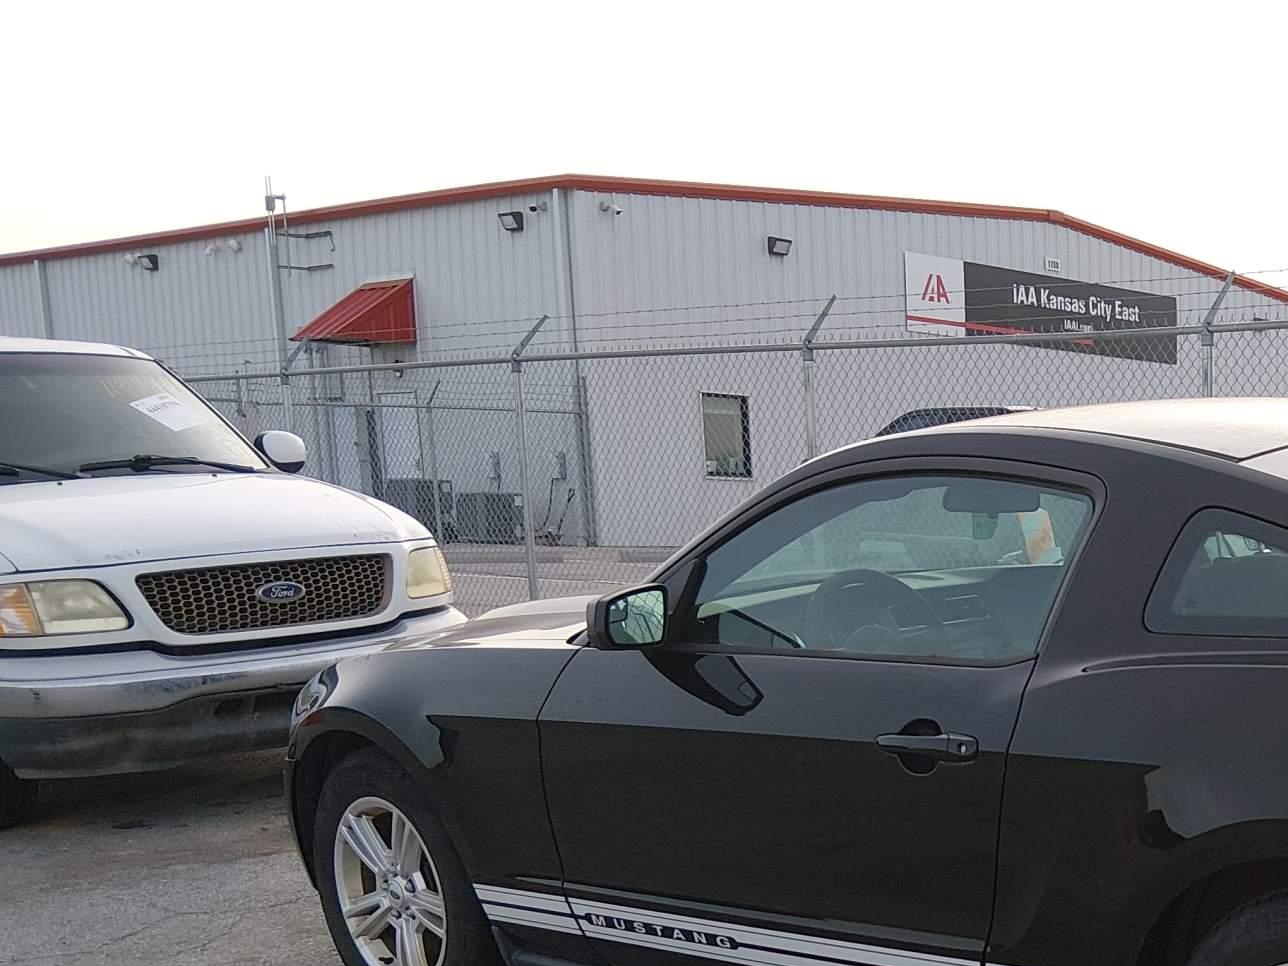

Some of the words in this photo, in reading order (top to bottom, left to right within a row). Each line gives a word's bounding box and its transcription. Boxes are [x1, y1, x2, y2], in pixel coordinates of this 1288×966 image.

[1012, 283, 1037, 307] IAA
[1040, 287, 1086, 314] Kansas
[1088, 295, 1112, 322] City
[1115, 300, 1140, 322] East
[270, 585, 295, 598] Ford
[590, 914, 733, 949] MUSTANG
